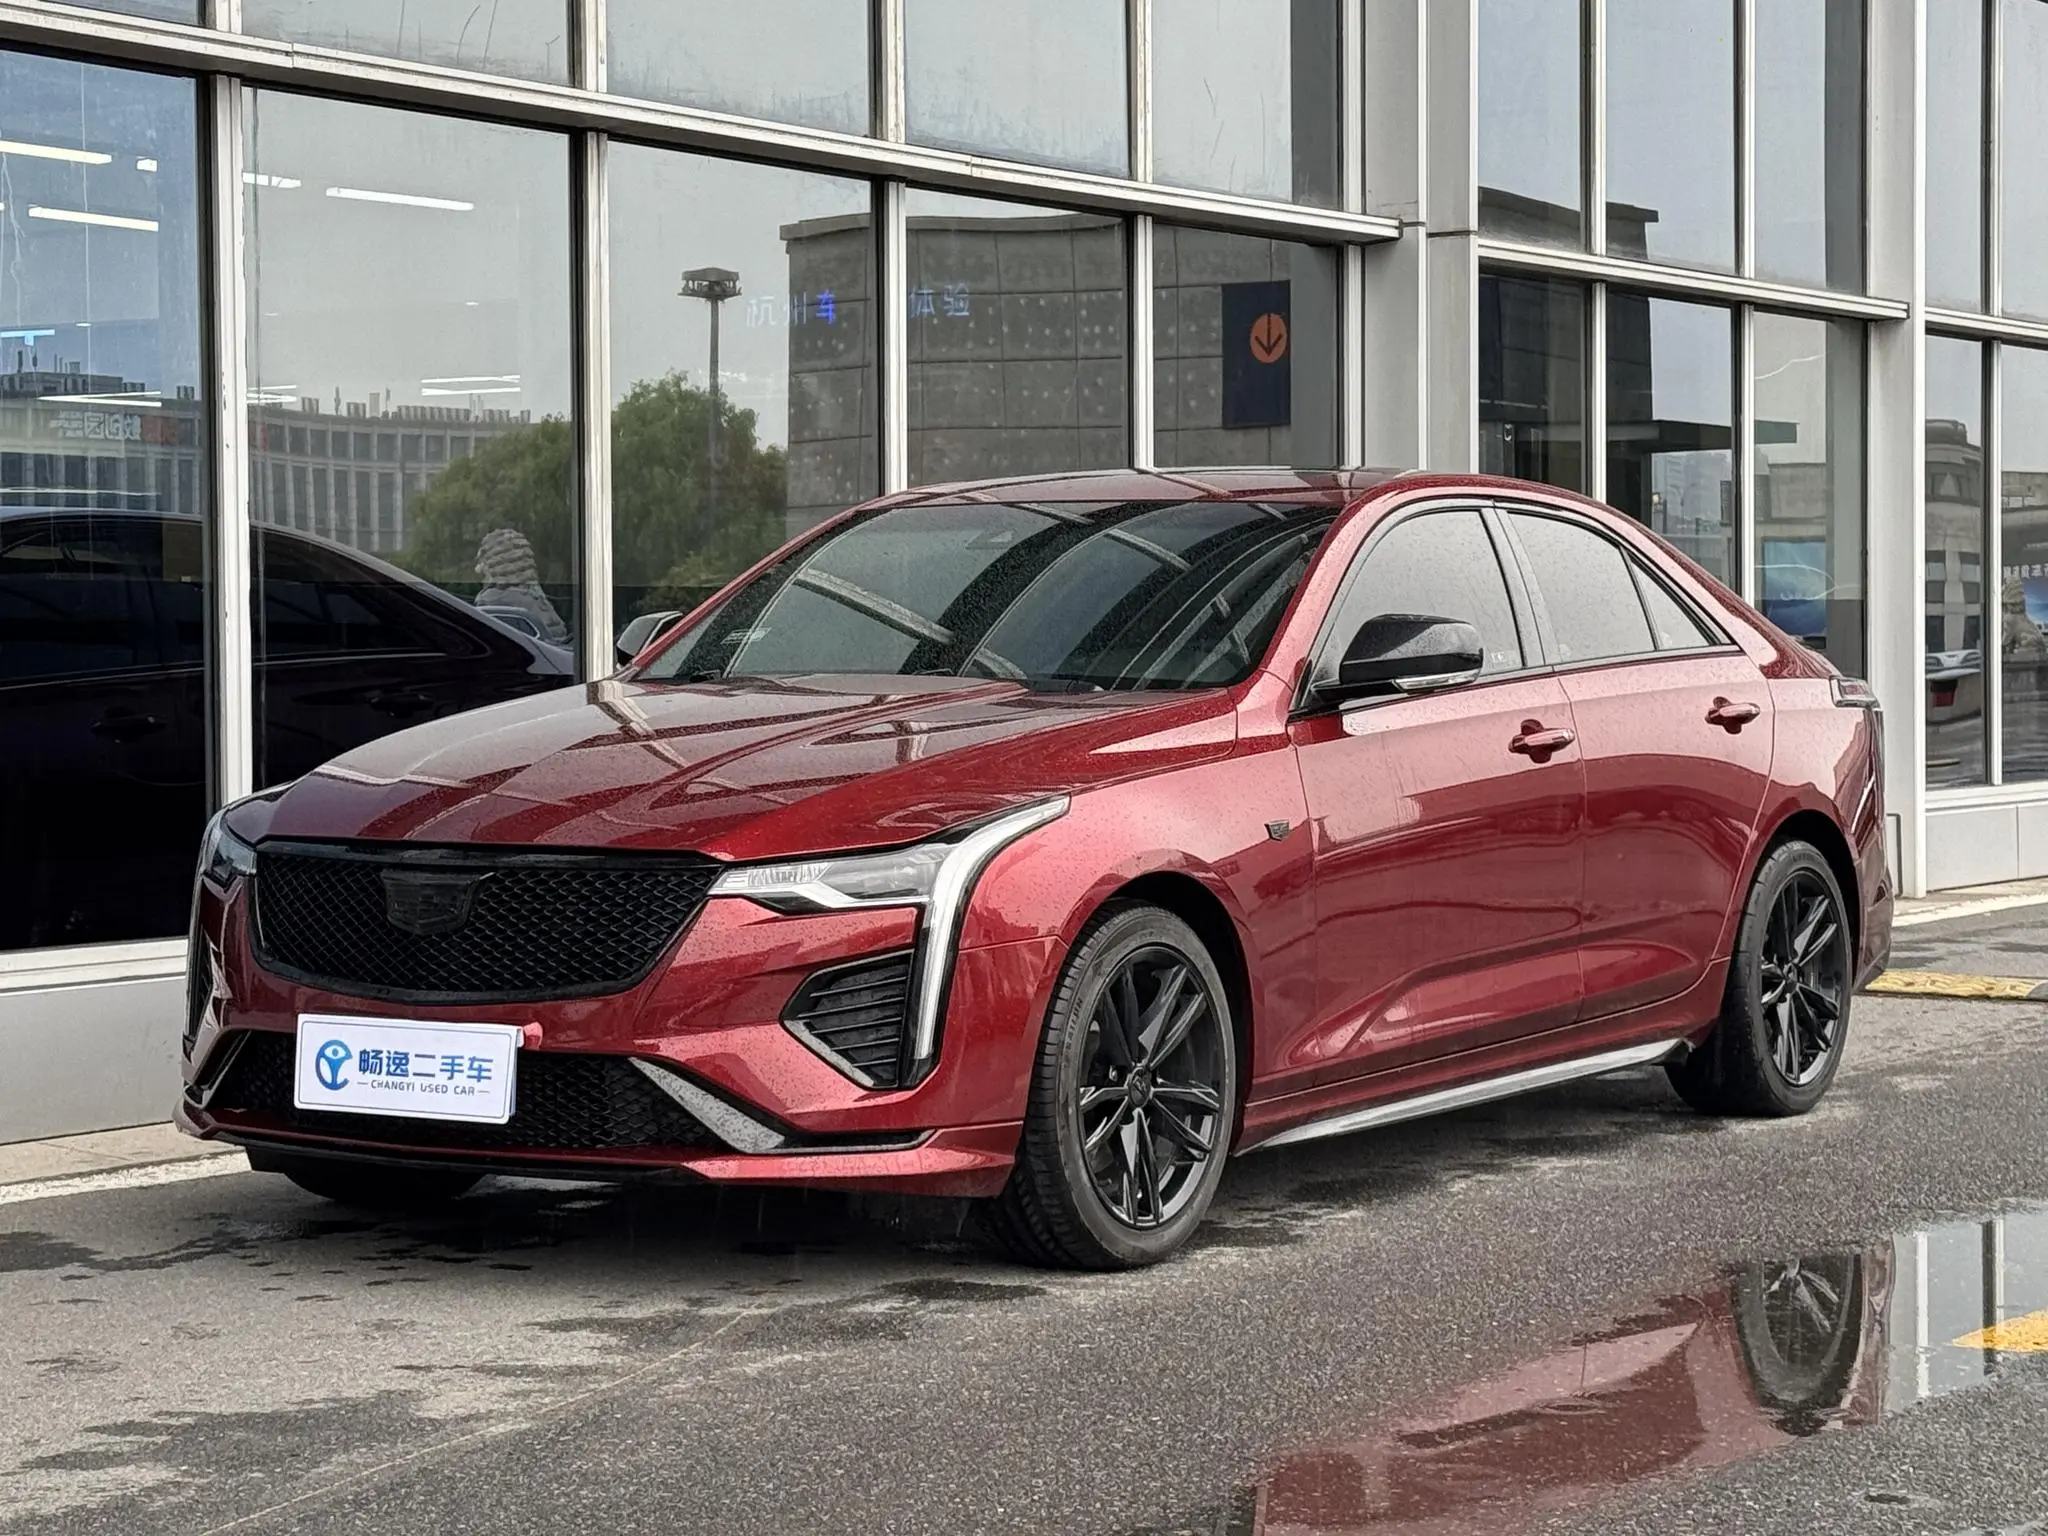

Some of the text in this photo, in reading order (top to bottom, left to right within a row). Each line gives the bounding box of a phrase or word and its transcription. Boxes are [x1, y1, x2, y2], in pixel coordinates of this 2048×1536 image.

[909, 283, 970, 318] 体验
[358, 1049, 494, 1082] 畅逸二手车
[370, 1079, 476, 1097] CHANGYI USED CAR
